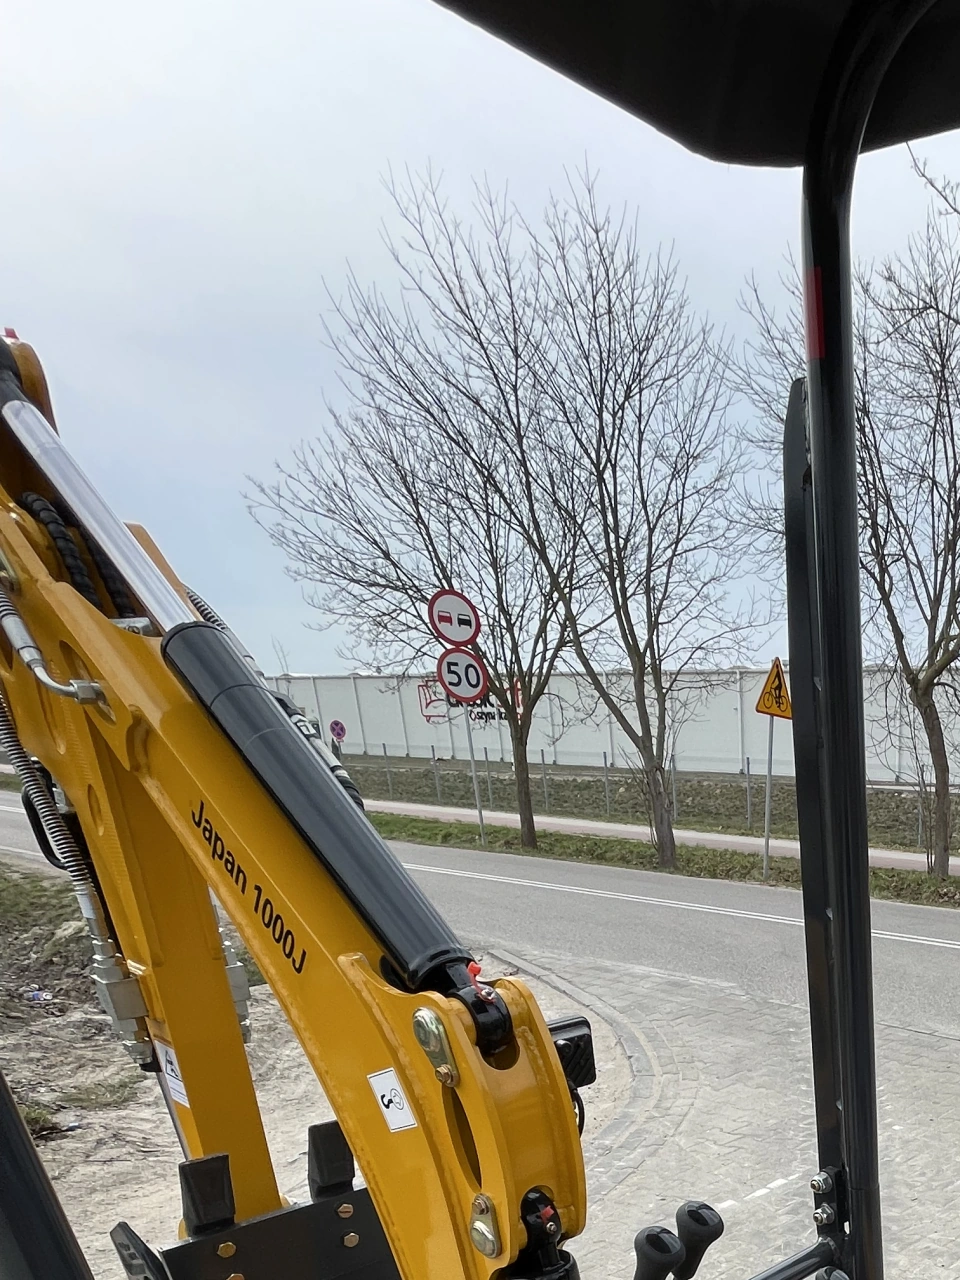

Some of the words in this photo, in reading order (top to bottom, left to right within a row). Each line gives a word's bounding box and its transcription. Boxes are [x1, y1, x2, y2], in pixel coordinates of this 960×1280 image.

[446, 661, 480, 688] 50
[191, 800, 248, 895] Japan
[254, 884, 307, 975] 1000J
